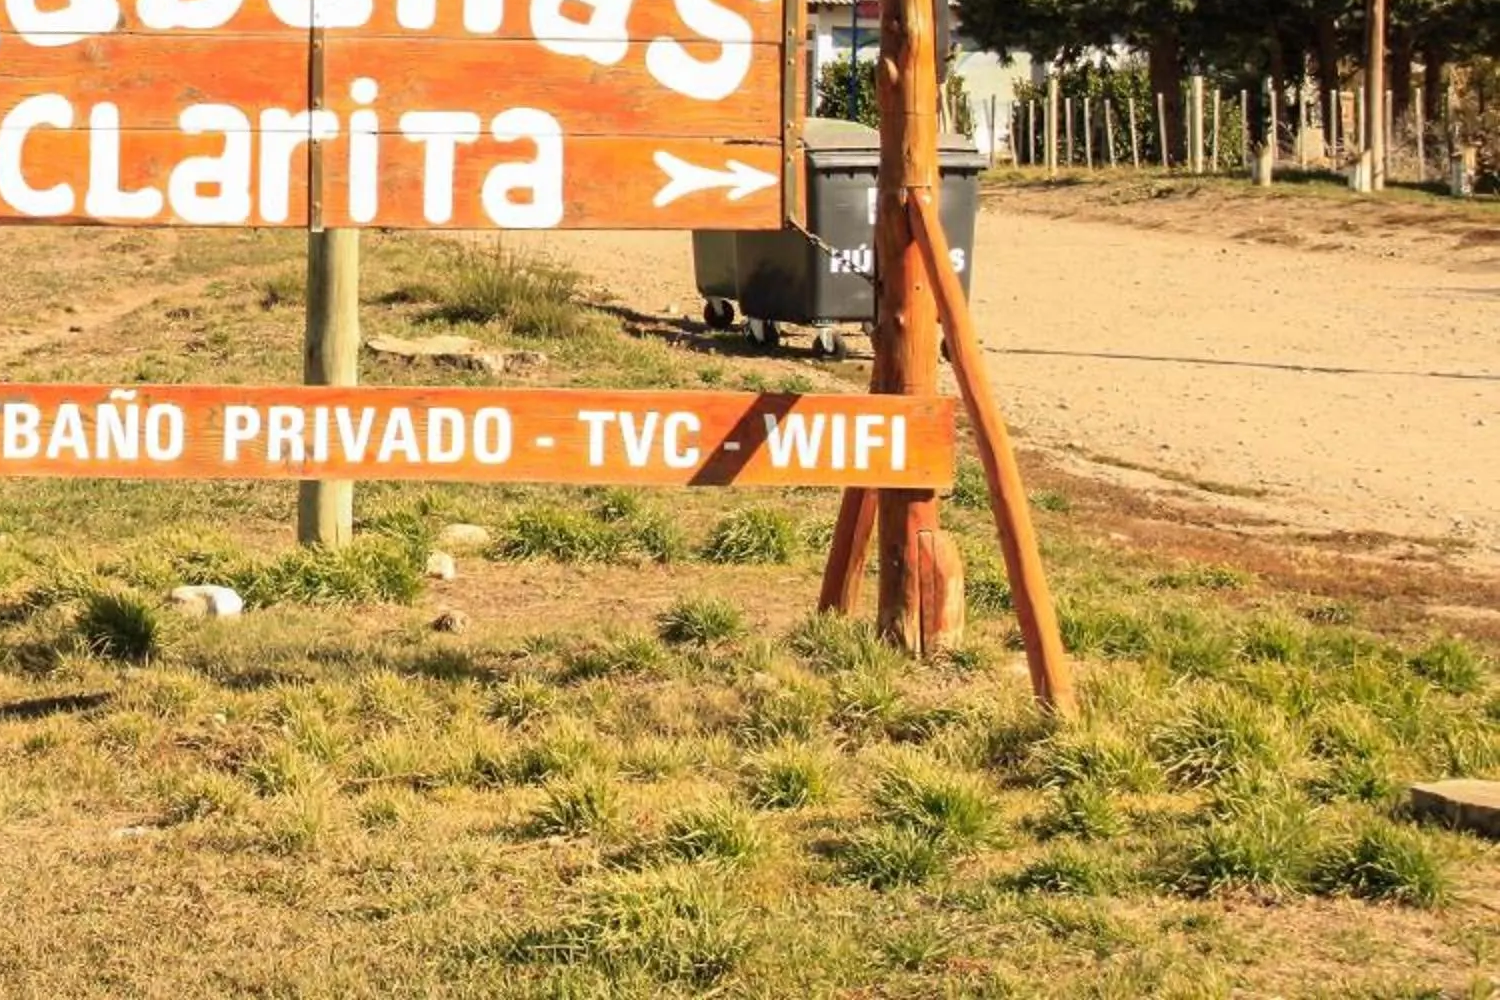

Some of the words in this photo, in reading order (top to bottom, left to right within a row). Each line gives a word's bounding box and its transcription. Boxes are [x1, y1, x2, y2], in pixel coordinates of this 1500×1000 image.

[222, 405, 514, 465] PRIVADO
[577, 410, 701, 469] TVC
[764, 413, 907, 471] WIFI
